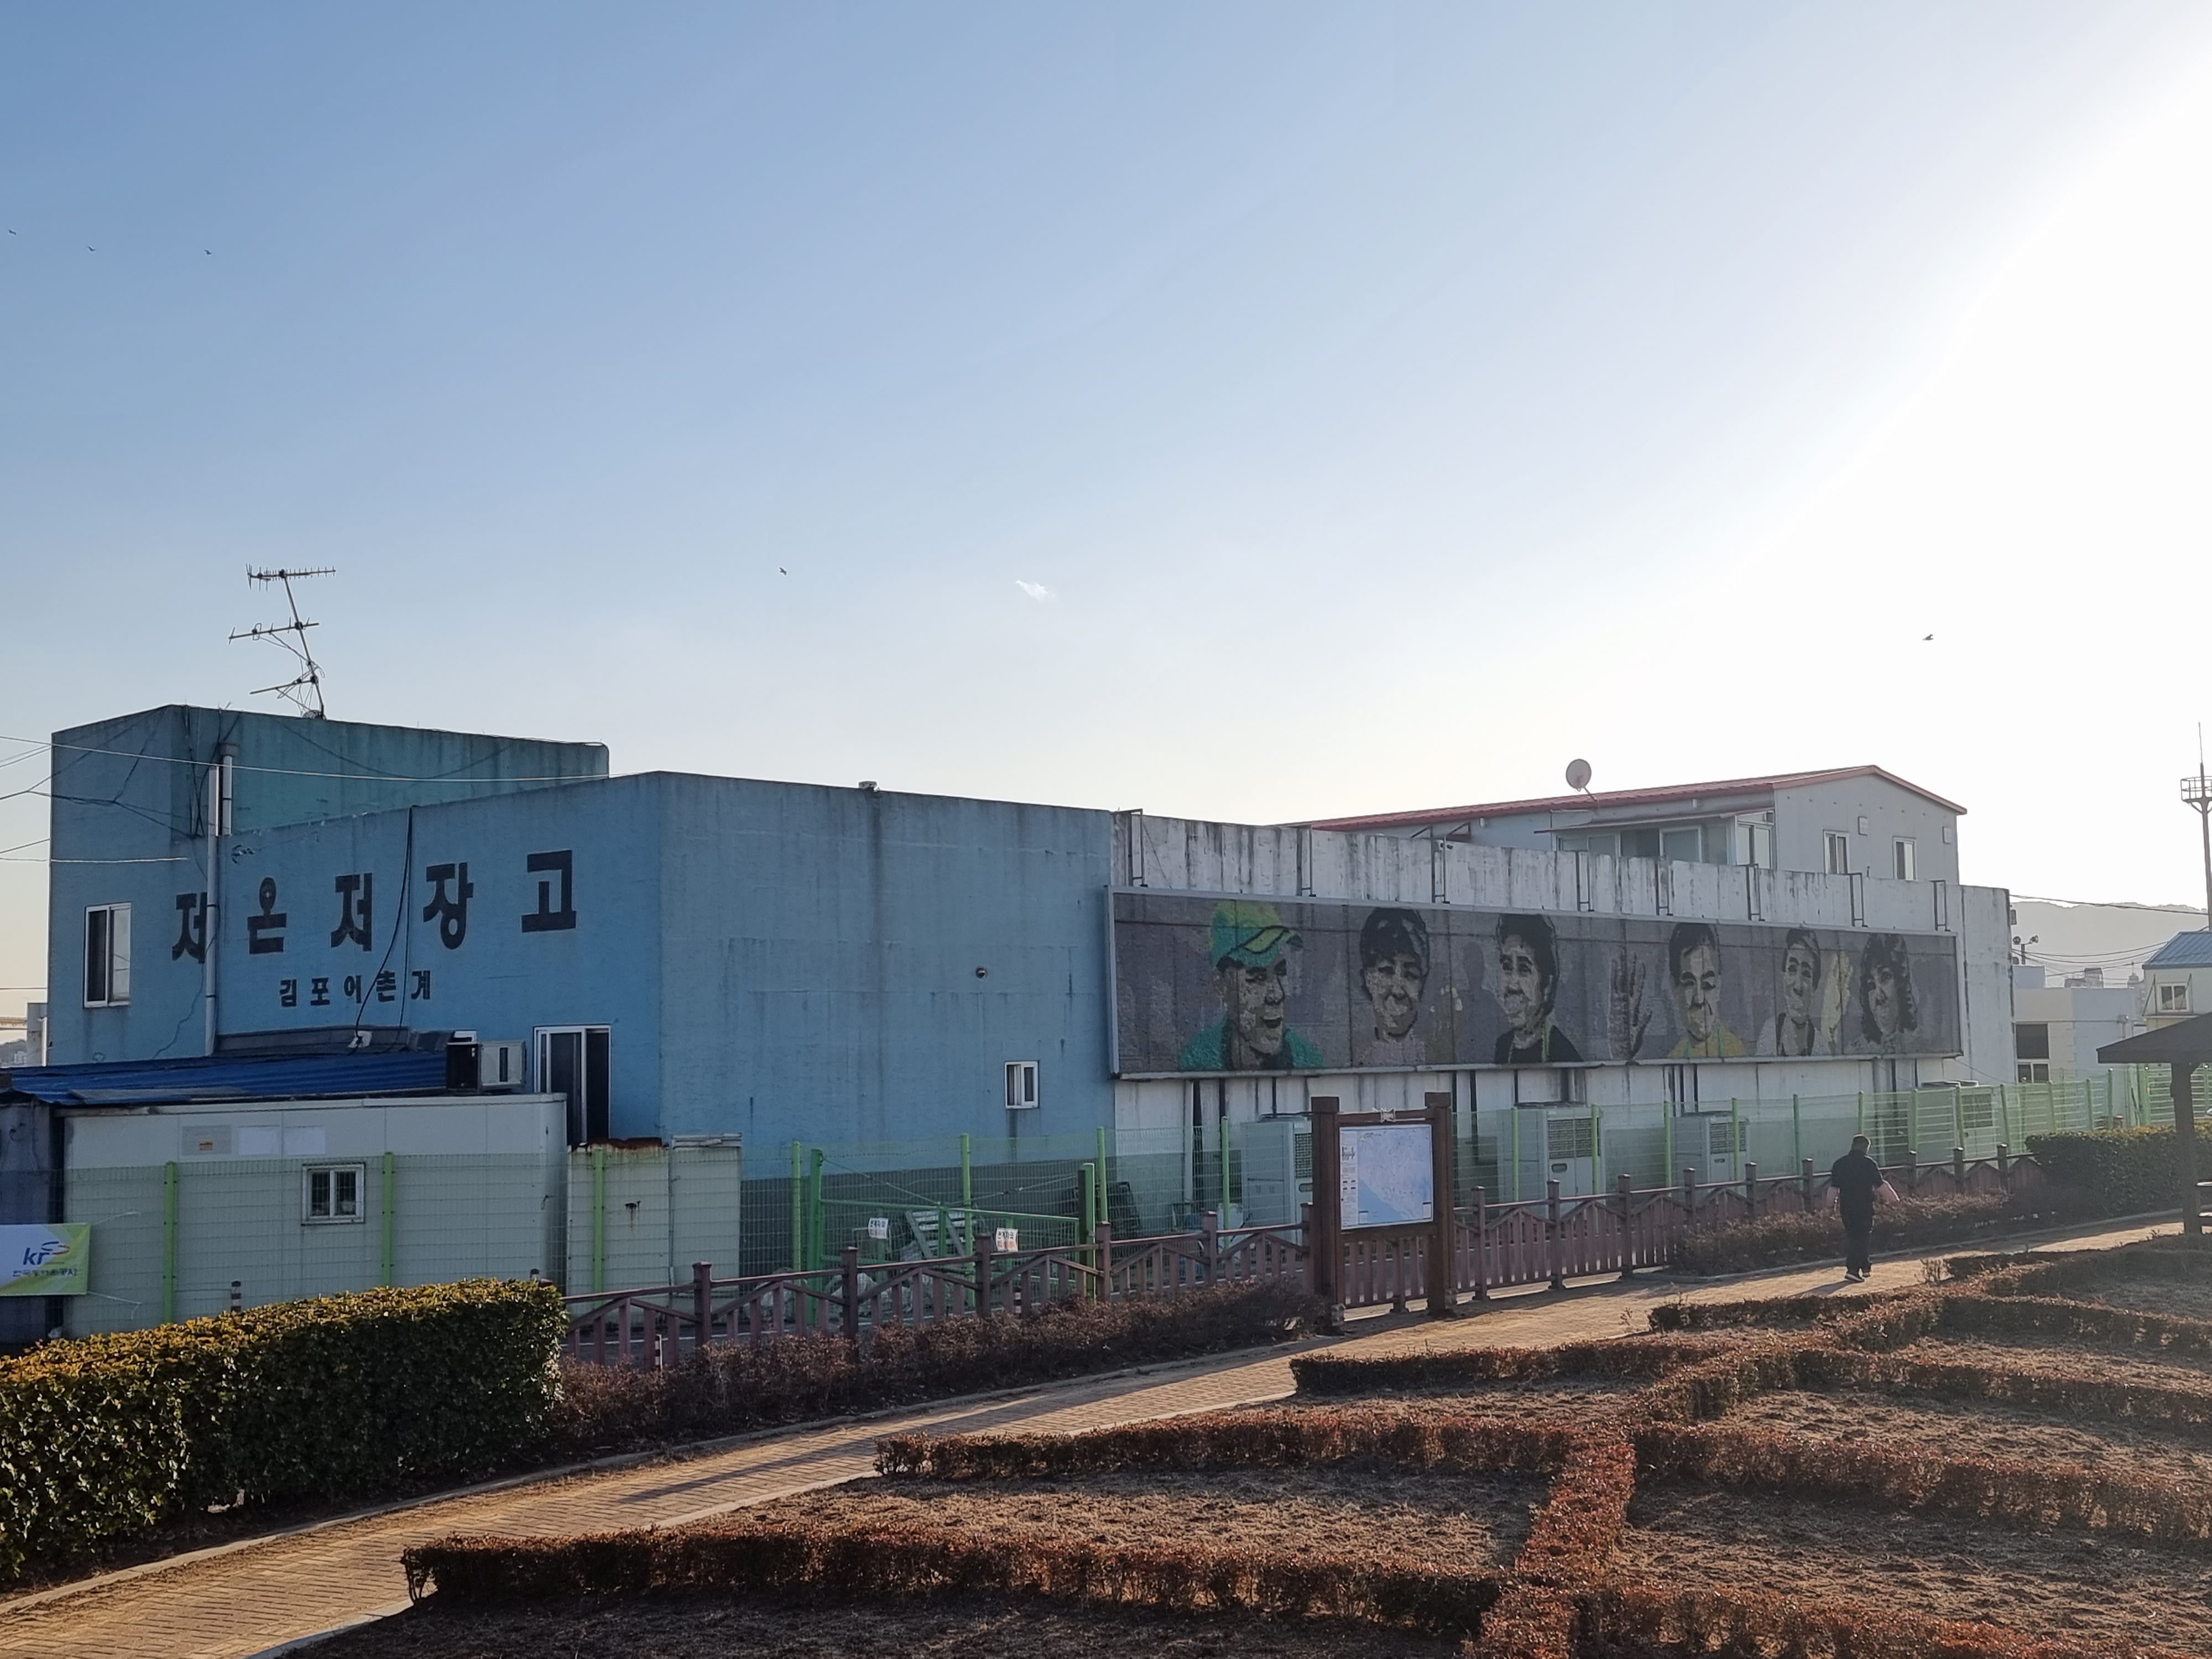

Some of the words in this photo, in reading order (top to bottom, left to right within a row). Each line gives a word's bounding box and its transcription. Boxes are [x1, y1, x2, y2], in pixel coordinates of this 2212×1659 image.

[171, 849, 577, 964] 저온저장고
[279, 970, 431, 1008] 김포어촌계
[23, 1247, 50, 1265] kr
